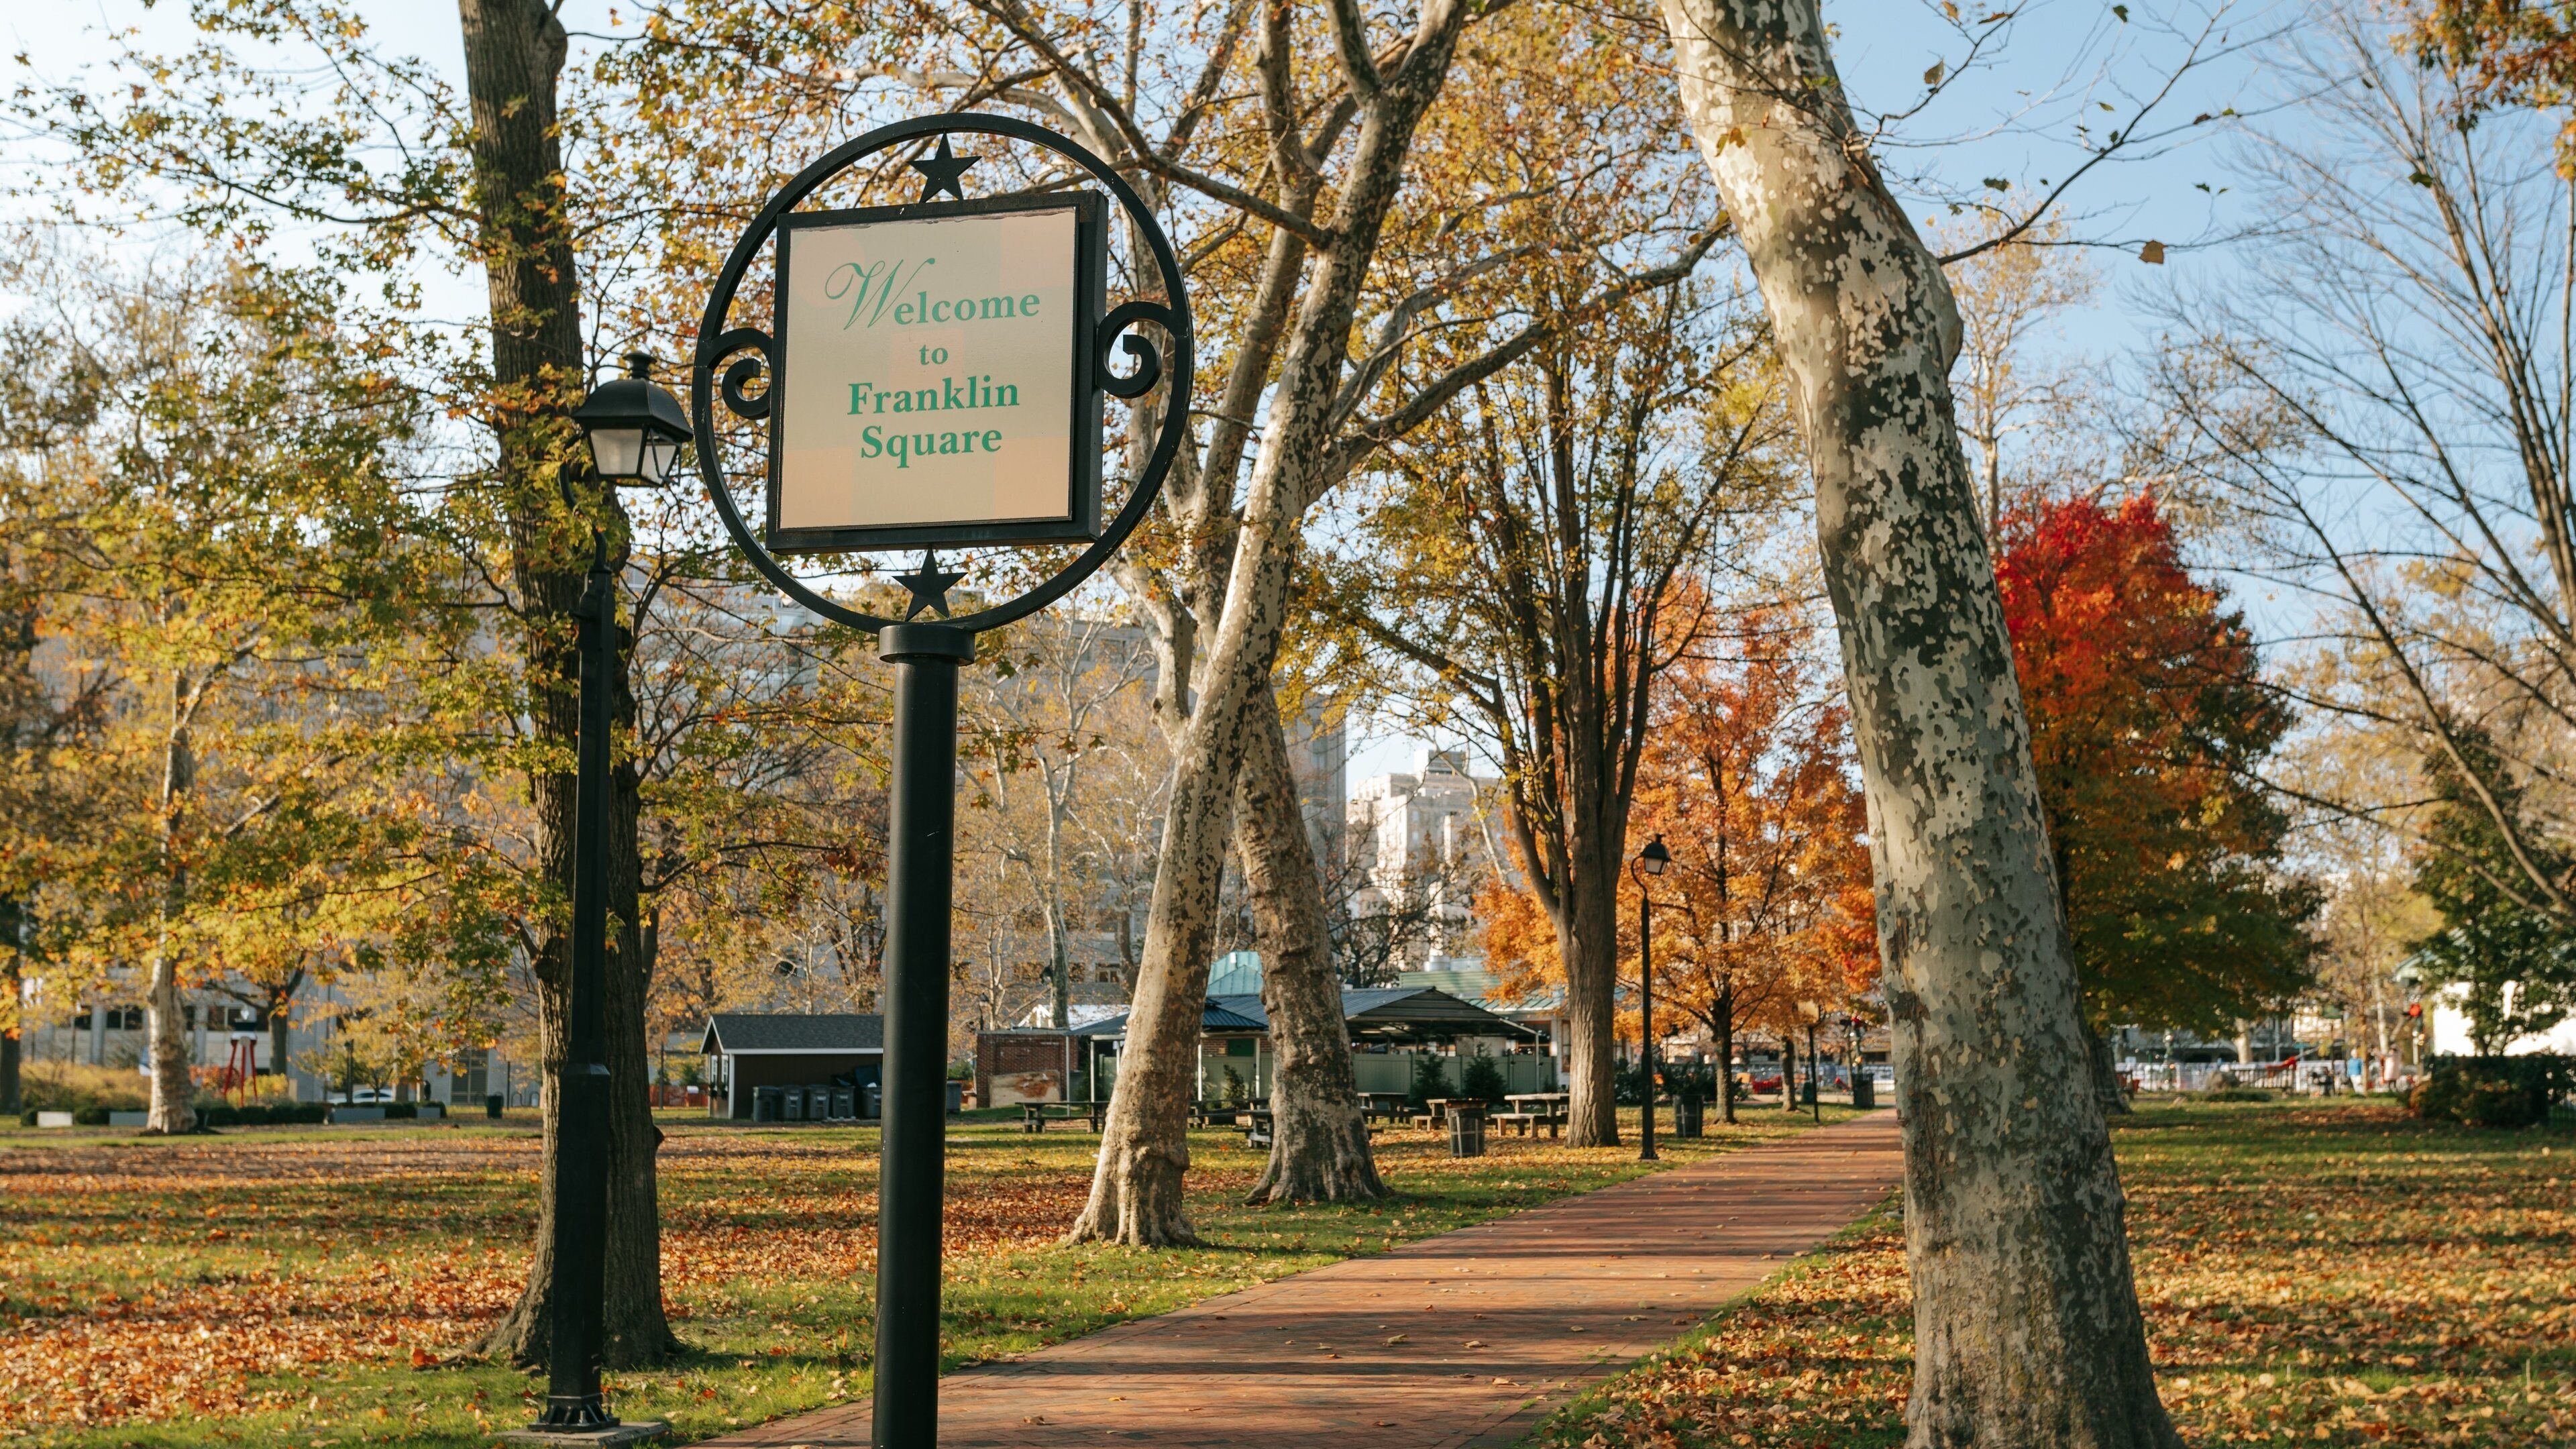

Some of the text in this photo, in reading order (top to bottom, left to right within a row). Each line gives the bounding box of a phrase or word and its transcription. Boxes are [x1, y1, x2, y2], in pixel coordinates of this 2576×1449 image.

[824, 257, 1040, 331] Welcome
[918, 344, 949, 366] to
[847, 374, 1020, 416] Franklin
[860, 423, 1004, 470] Square
